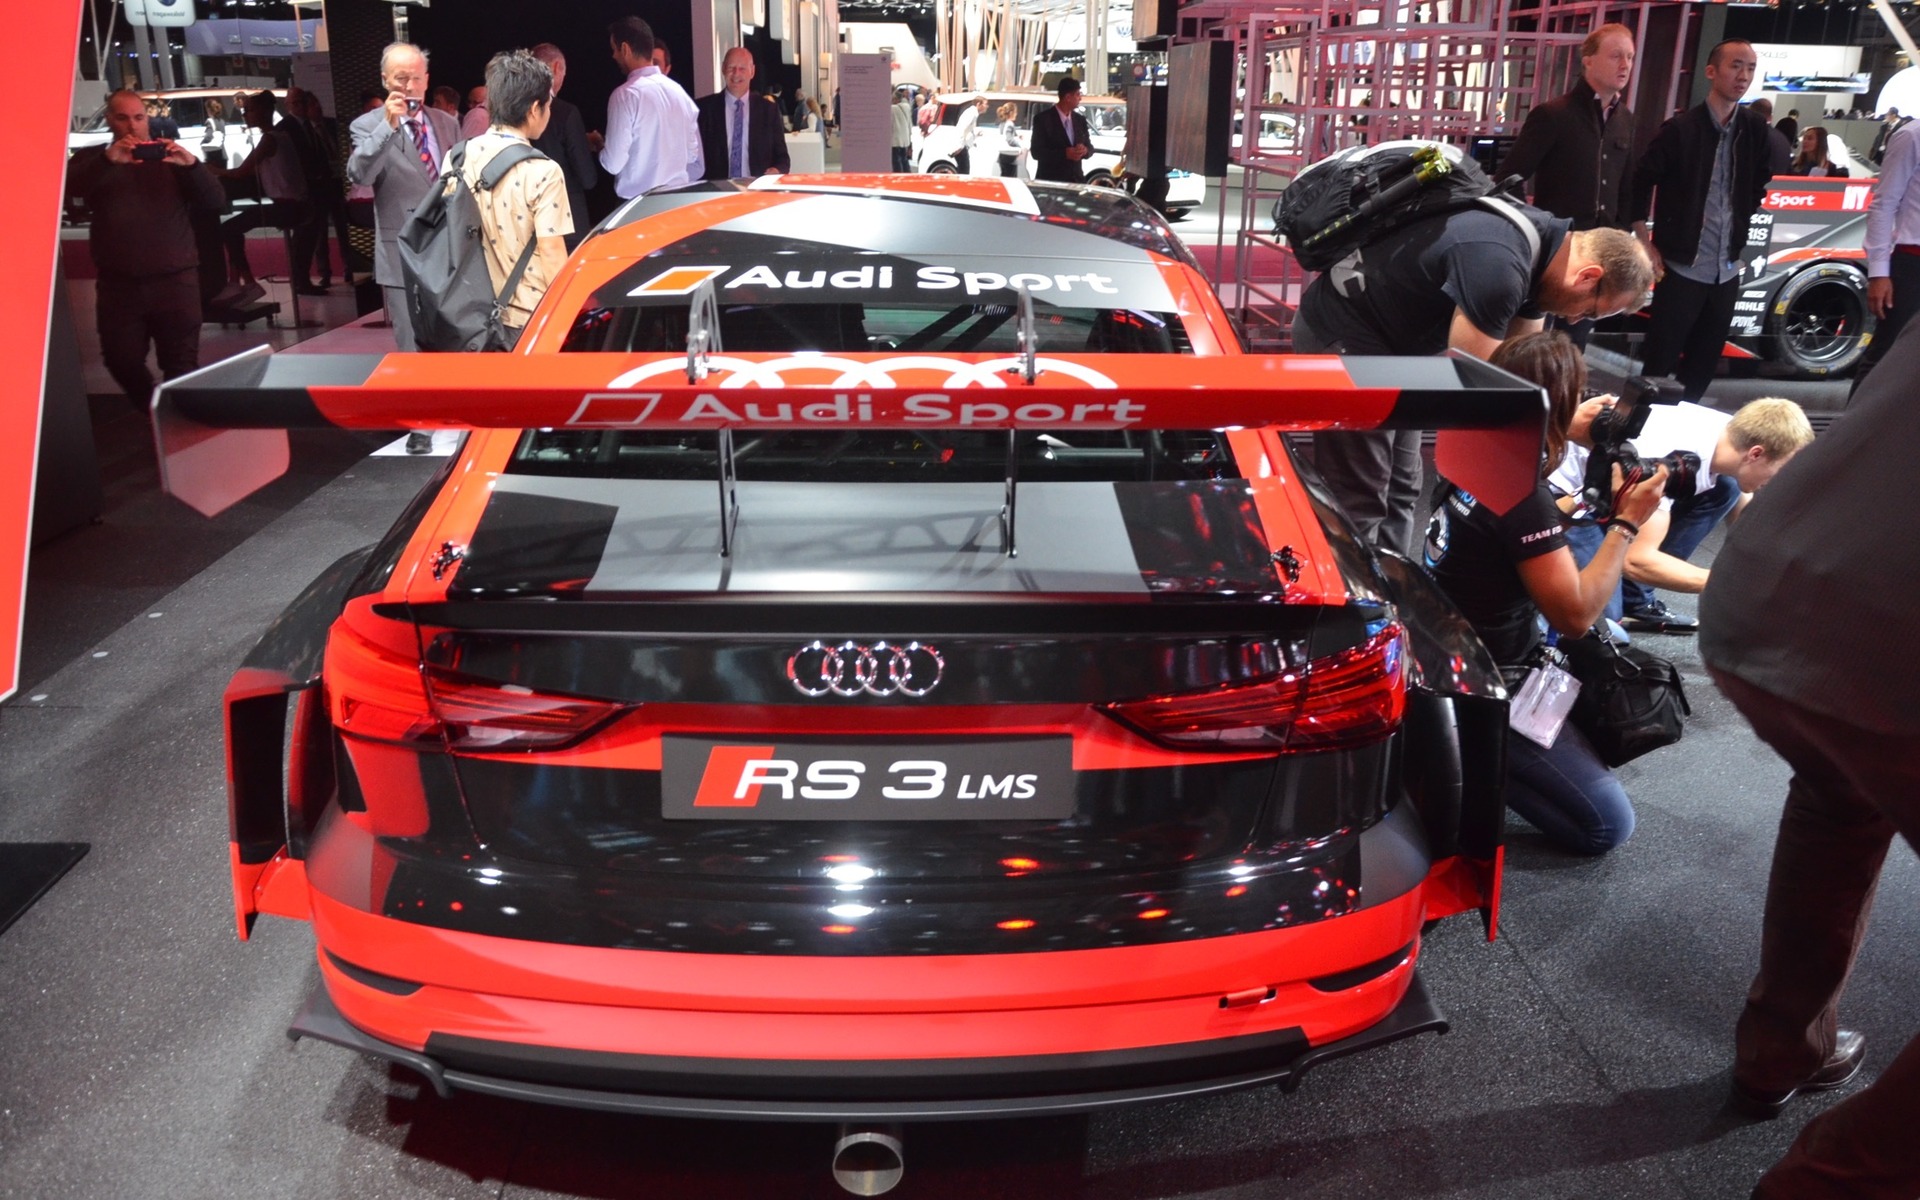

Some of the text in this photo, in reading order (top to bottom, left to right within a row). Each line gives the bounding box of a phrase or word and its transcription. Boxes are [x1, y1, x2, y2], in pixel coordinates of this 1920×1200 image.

[1769, 192, 1816, 208] Sport
[1749, 213, 1774, 225] SCH
[725, 265, 1119, 295] Audi Sport
[679, 394, 1146, 424] Audi Sport
[1520, 528, 1551, 544] TEAM
[733, 759, 1038, 800] RS 3 LMS
